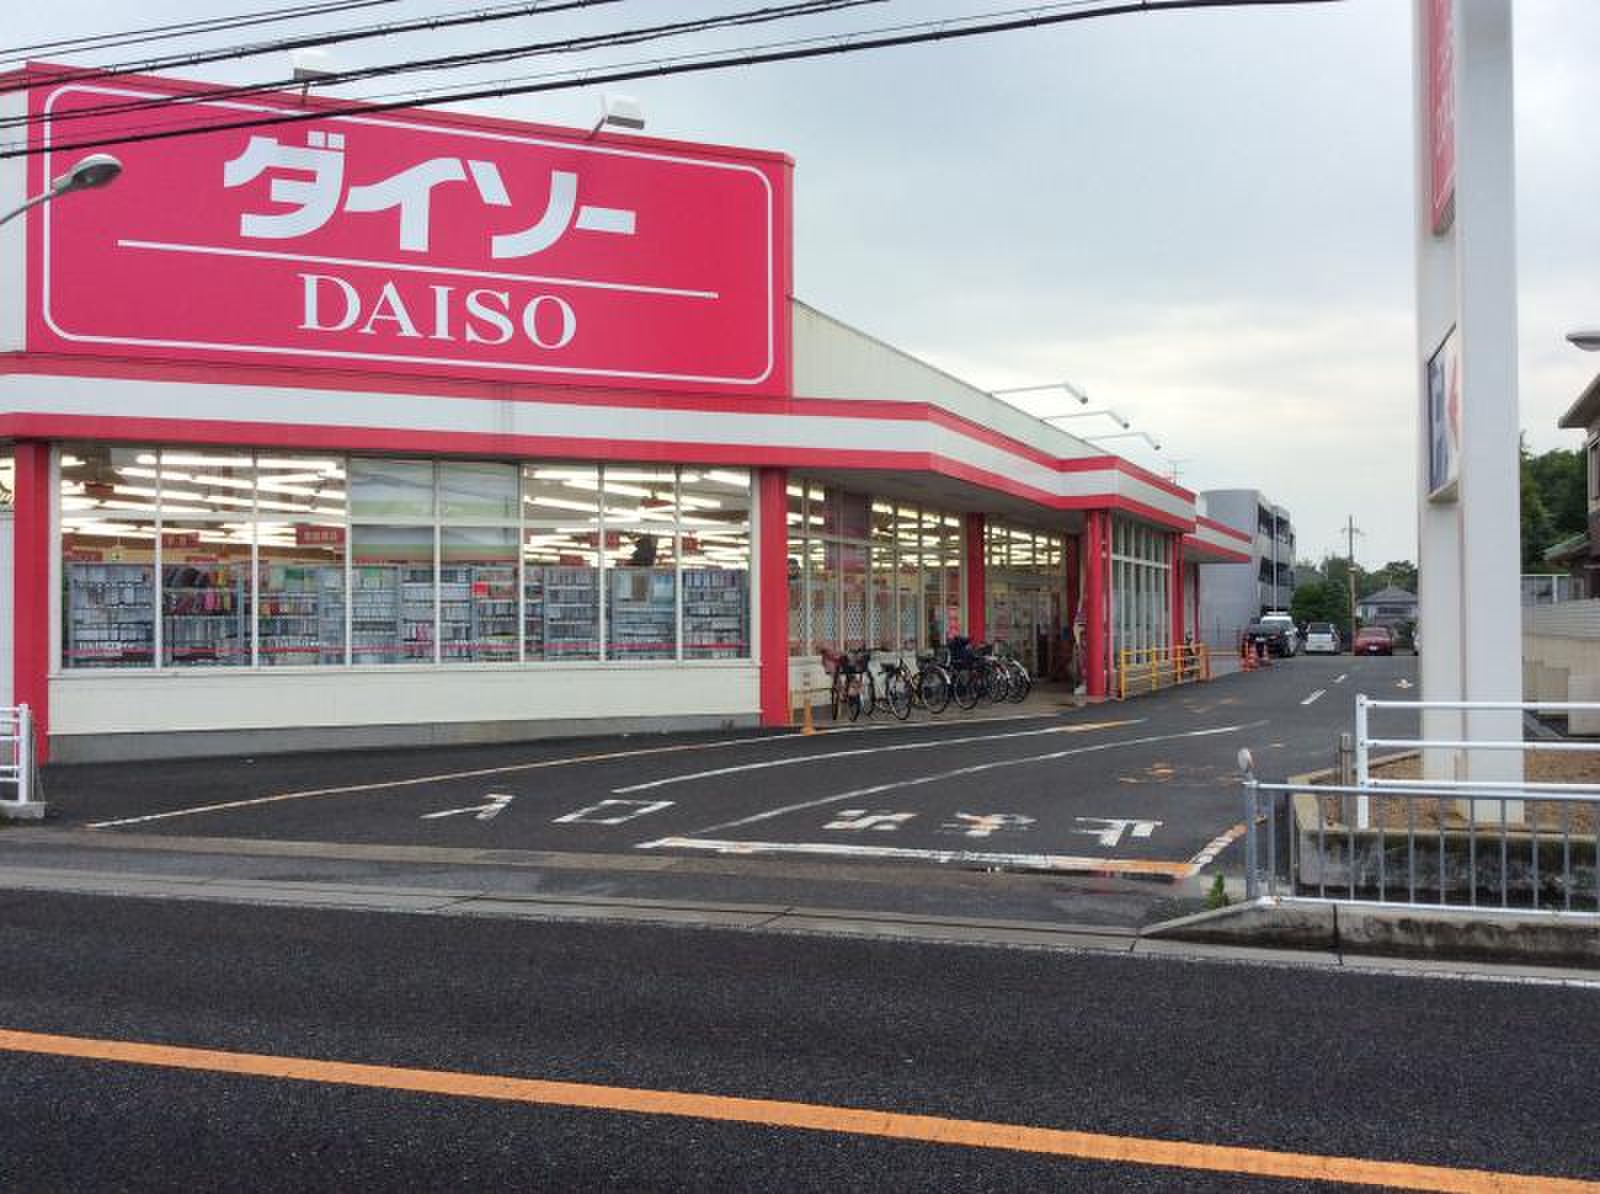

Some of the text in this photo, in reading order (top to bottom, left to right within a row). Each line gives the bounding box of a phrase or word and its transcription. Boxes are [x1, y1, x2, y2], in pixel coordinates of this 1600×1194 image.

[224, 132, 636, 259] ダイソー
[297, 273, 577, 350] DAISO
